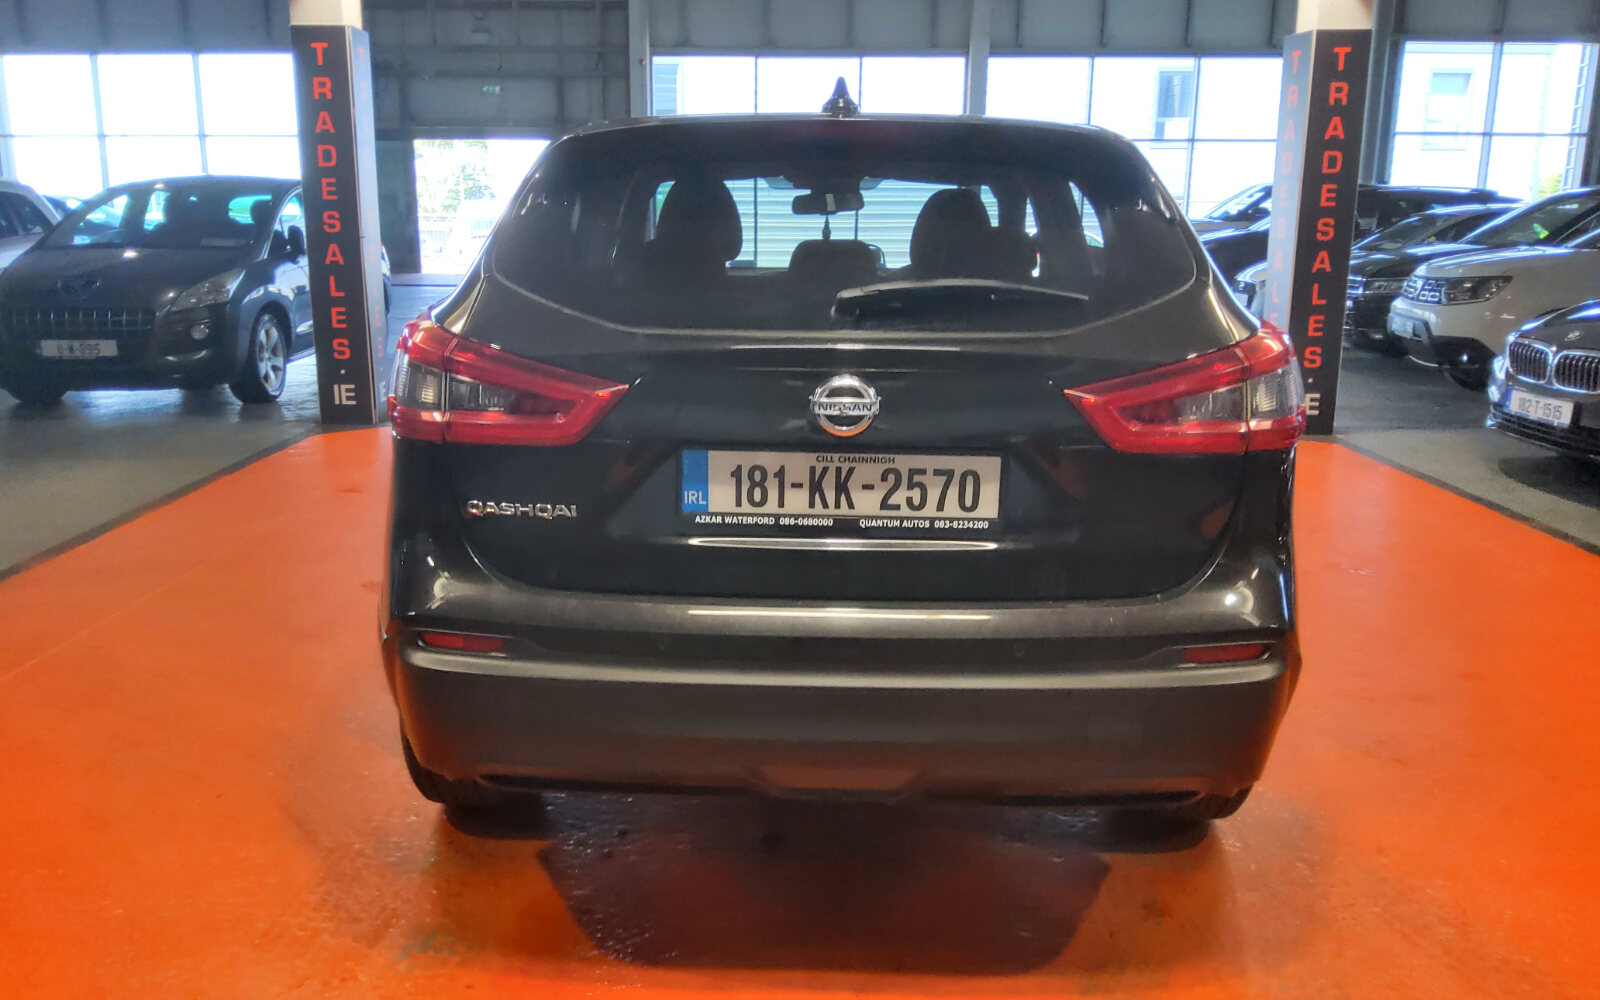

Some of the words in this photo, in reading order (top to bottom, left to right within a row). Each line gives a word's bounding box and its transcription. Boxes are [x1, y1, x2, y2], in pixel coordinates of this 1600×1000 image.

[1303, 47, 1352, 416] TRADESALES.E
[818, 403, 872, 412] NISSAN
[816, 455, 835, 463] CILL
[838, 455, 896, 465] CHAINNIGH
[730, 464, 980, 513] 181-KK-2570
[684, 490, 707, 505] IRL
[466, 500, 577, 519] QASHQAI
[695, 515, 722, 524] AZKAR
[724, 515, 775, 525] WATERFORD
[859, 518, 900, 528] QUANTUM
[902, 519, 930, 528] AUTOS
[934, 520, 989, 529] 083-8234200
